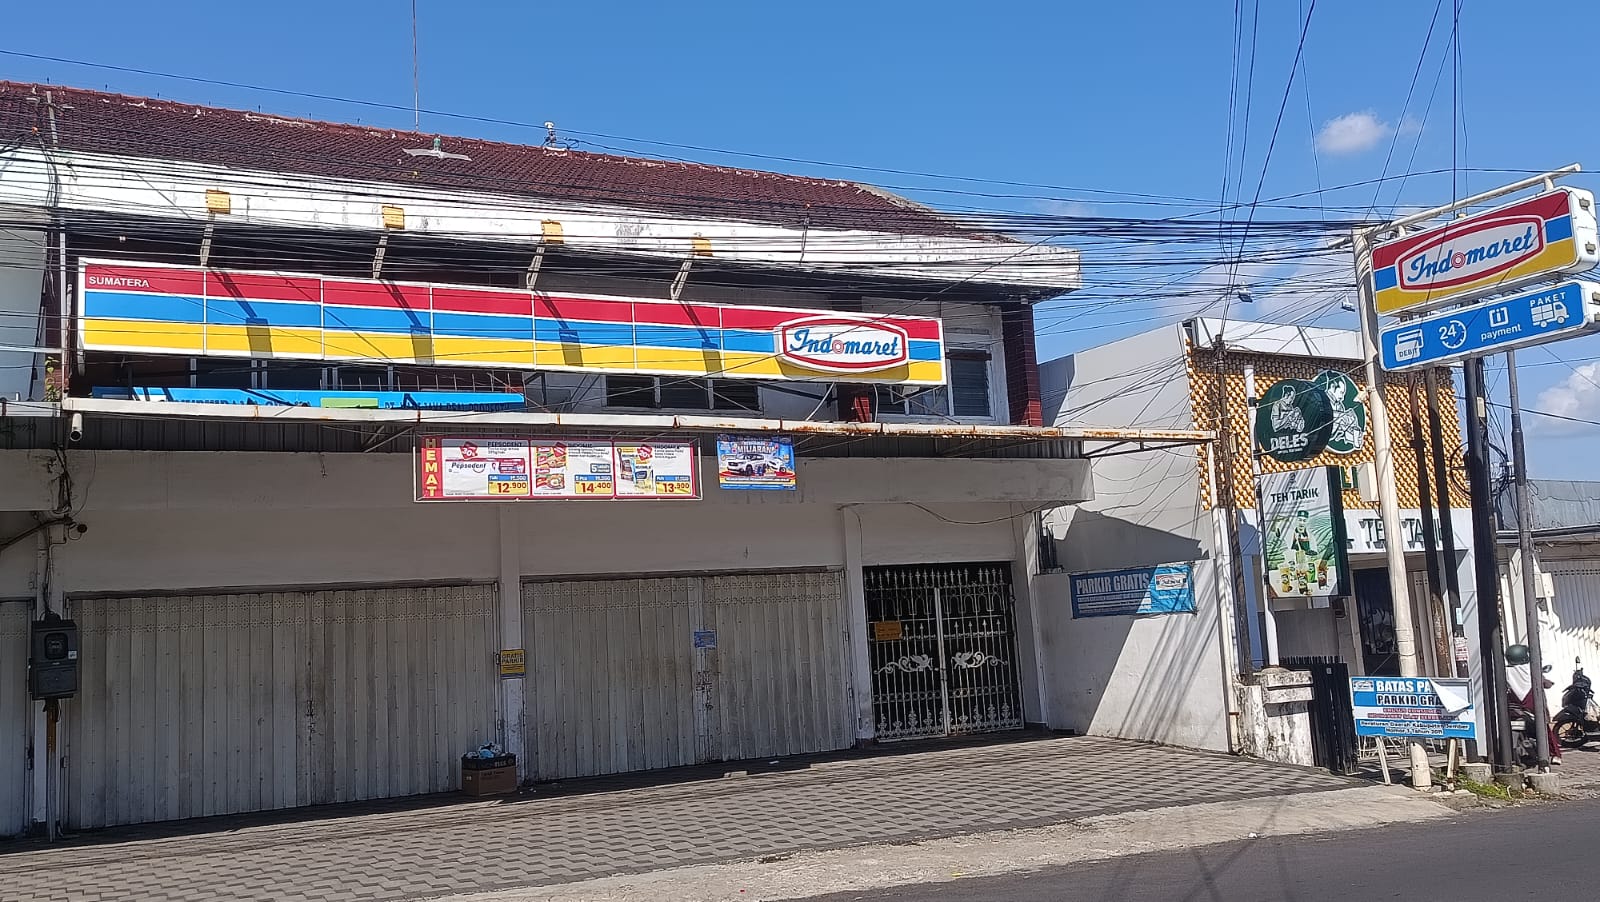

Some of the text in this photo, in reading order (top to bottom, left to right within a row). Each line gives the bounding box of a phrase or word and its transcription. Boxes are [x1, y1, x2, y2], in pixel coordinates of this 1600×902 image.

[1407, 226, 1533, 283] Indomaret
[88, 275, 150, 288] SUMATERA
[1529, 291, 1567, 308] PAKET
[1438, 325, 1458, 341] 24
[1480, 322, 1523, 342] payment
[789, 328, 899, 357] Indomaret
[1398, 346, 1419, 359] DEBIT
[1270, 433, 1309, 451] DELES
[424, 438, 438, 497] HEMAT
[497, 482, 527, 493] 12.900
[581, 482, 611, 493] 14.400
[1271, 492, 1289, 503] TEH
[1290, 488, 1319, 501] TARIK
[1075, 572, 1150, 595] PARKIR GRATIS
[1376, 680, 1414, 693] BATAS
[1416, 681, 1434, 693] PA
[1377, 694, 1444, 706] PARKIR GRA
